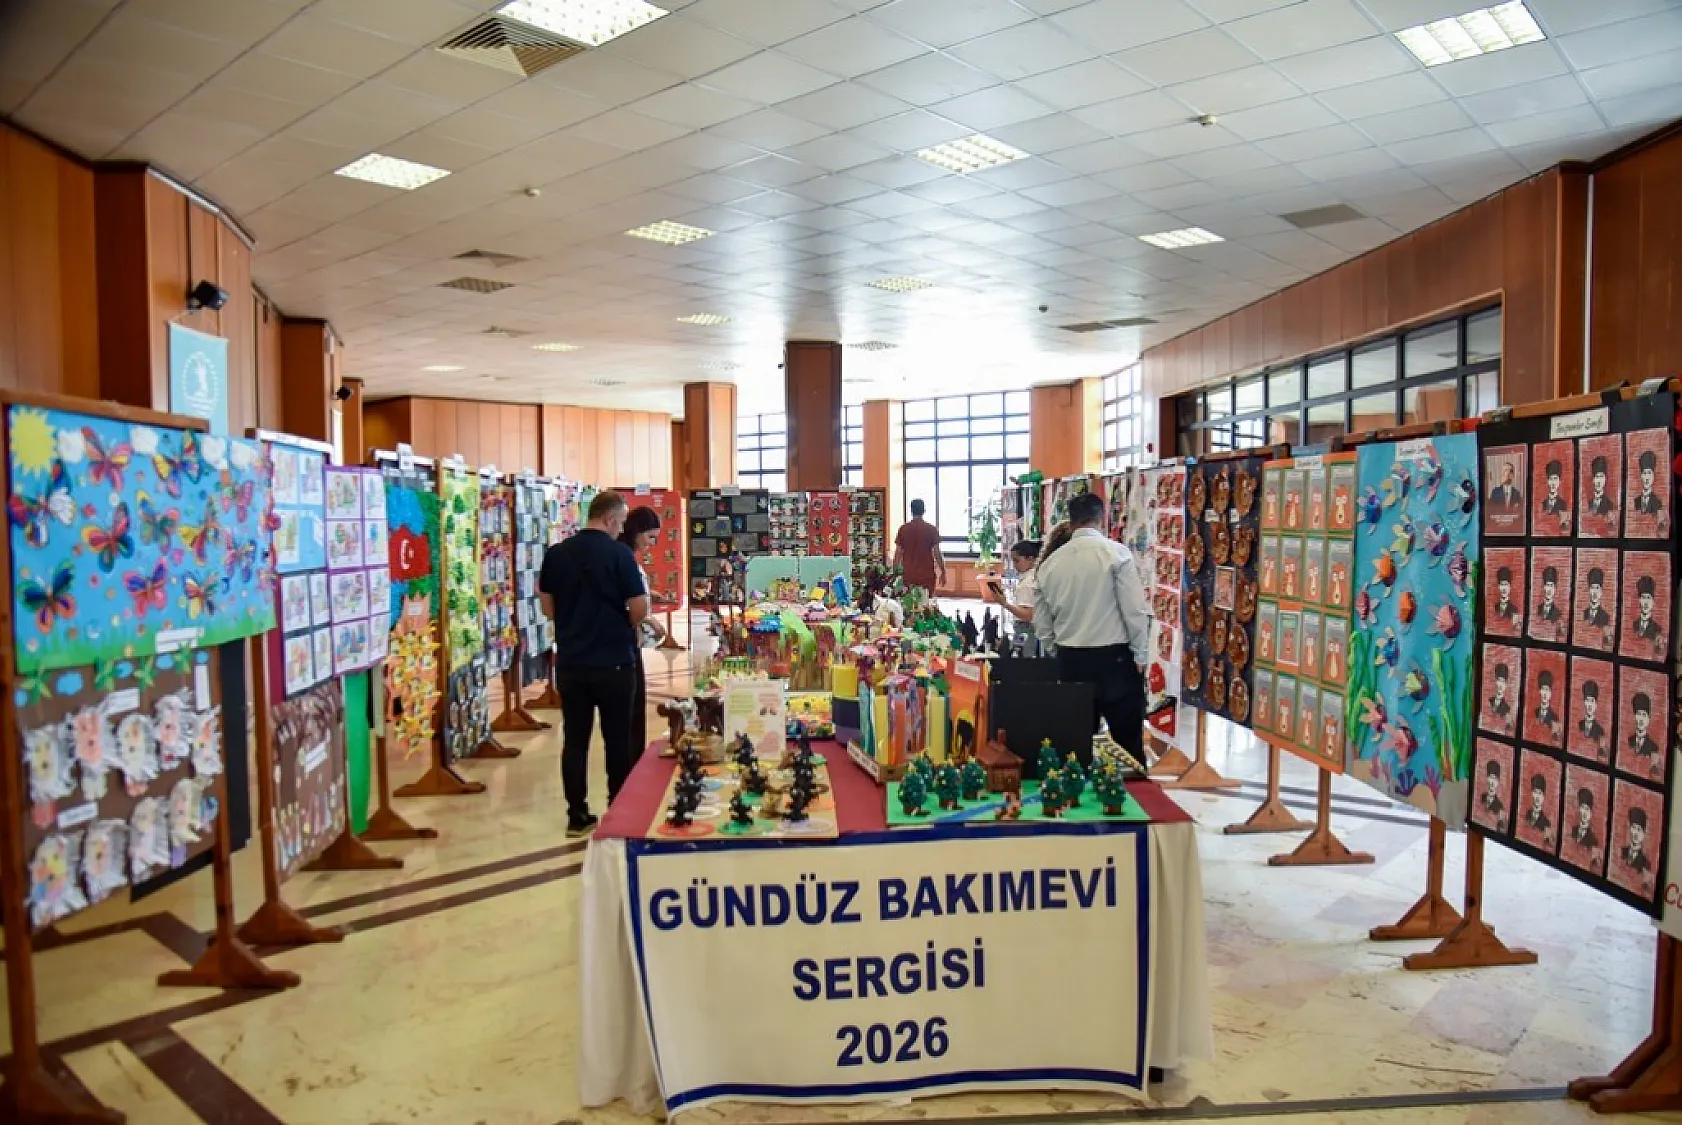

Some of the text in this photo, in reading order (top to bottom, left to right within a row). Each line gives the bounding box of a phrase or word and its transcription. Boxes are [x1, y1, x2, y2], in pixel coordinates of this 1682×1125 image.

[650, 856, 1116, 930] GÜNDÜZ BAKIMEVİ
[792, 937, 985, 1001] SERGİSİ
[836, 1015, 950, 1067] 2026
